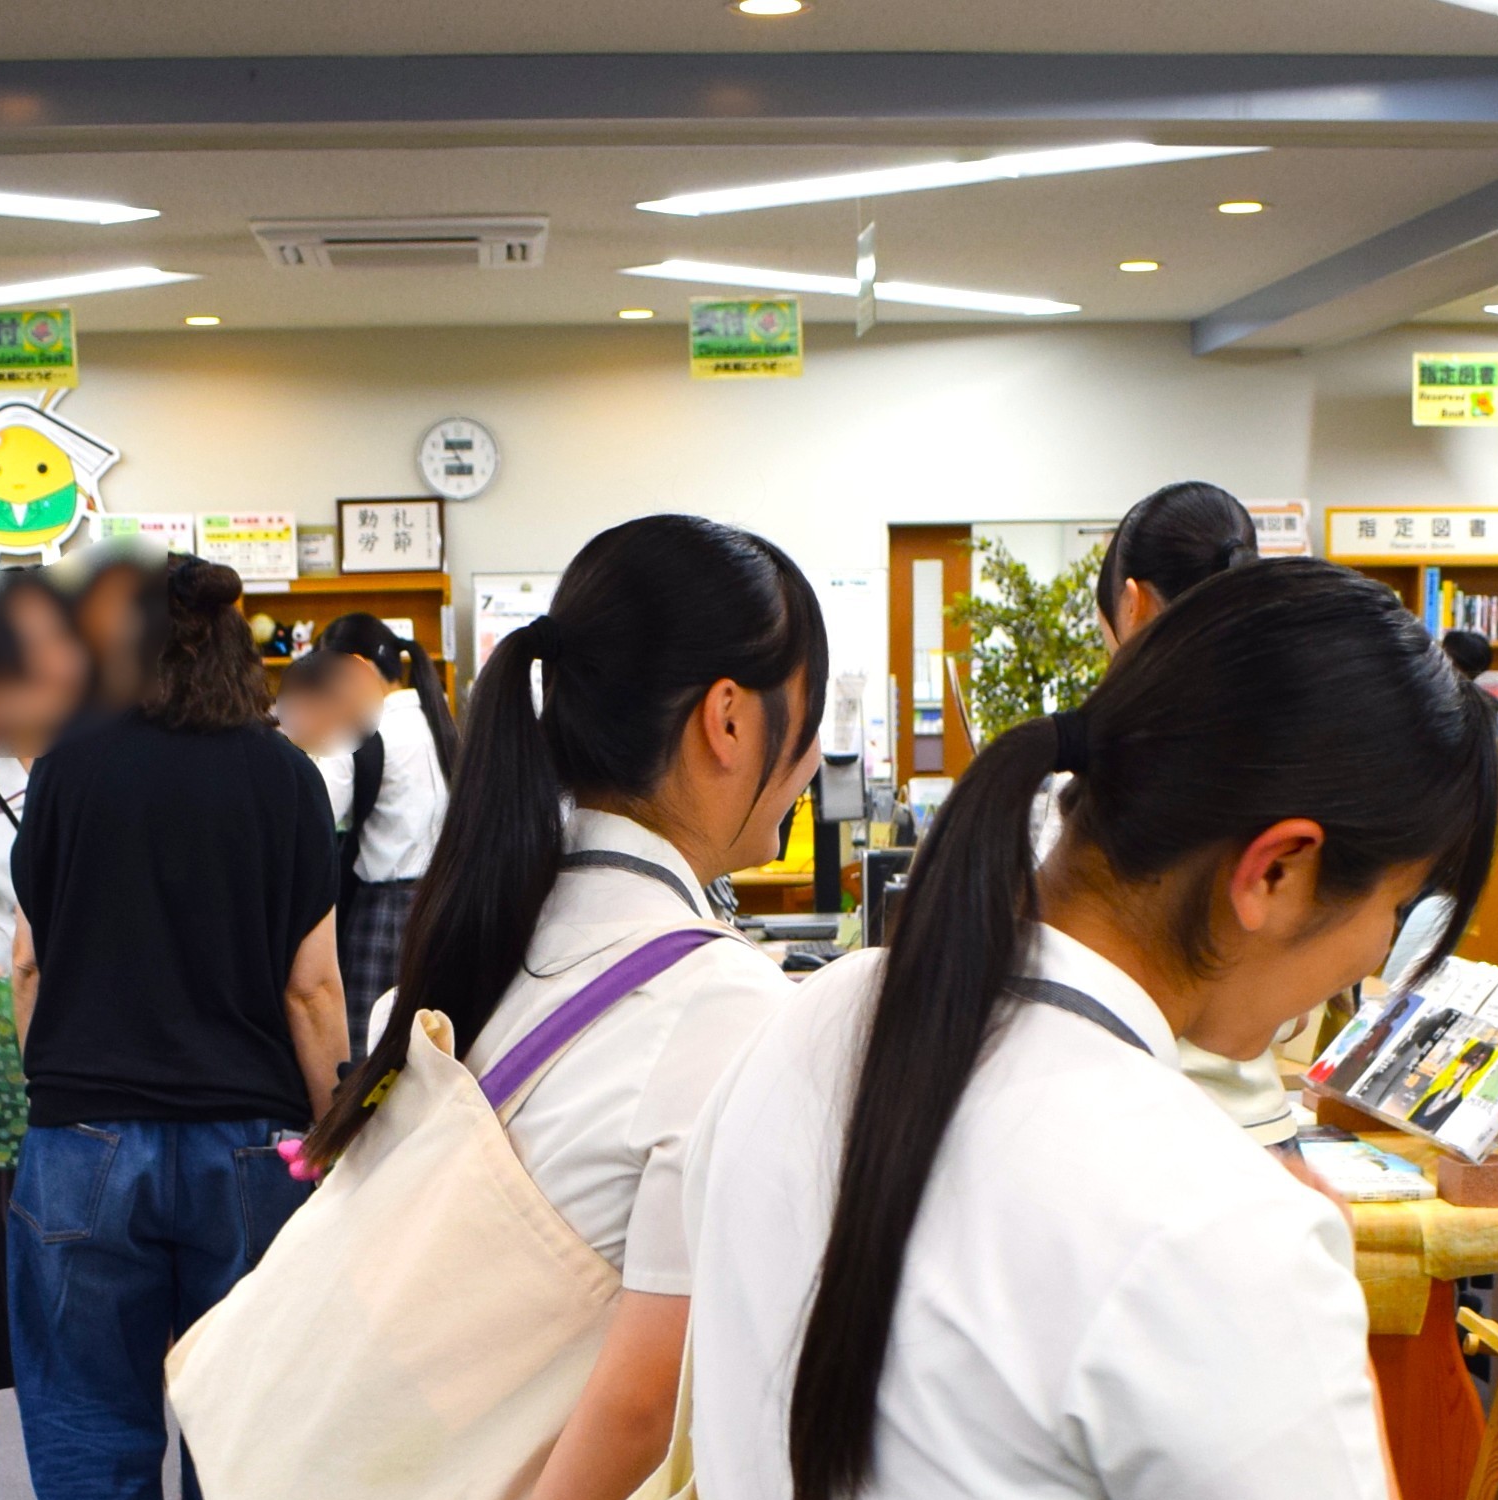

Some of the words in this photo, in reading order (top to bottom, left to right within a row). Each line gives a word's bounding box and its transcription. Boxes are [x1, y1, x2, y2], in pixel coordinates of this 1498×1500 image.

[1358, 517, 1487, 540] 指定図書
[481, 594, 494, 610] 7
